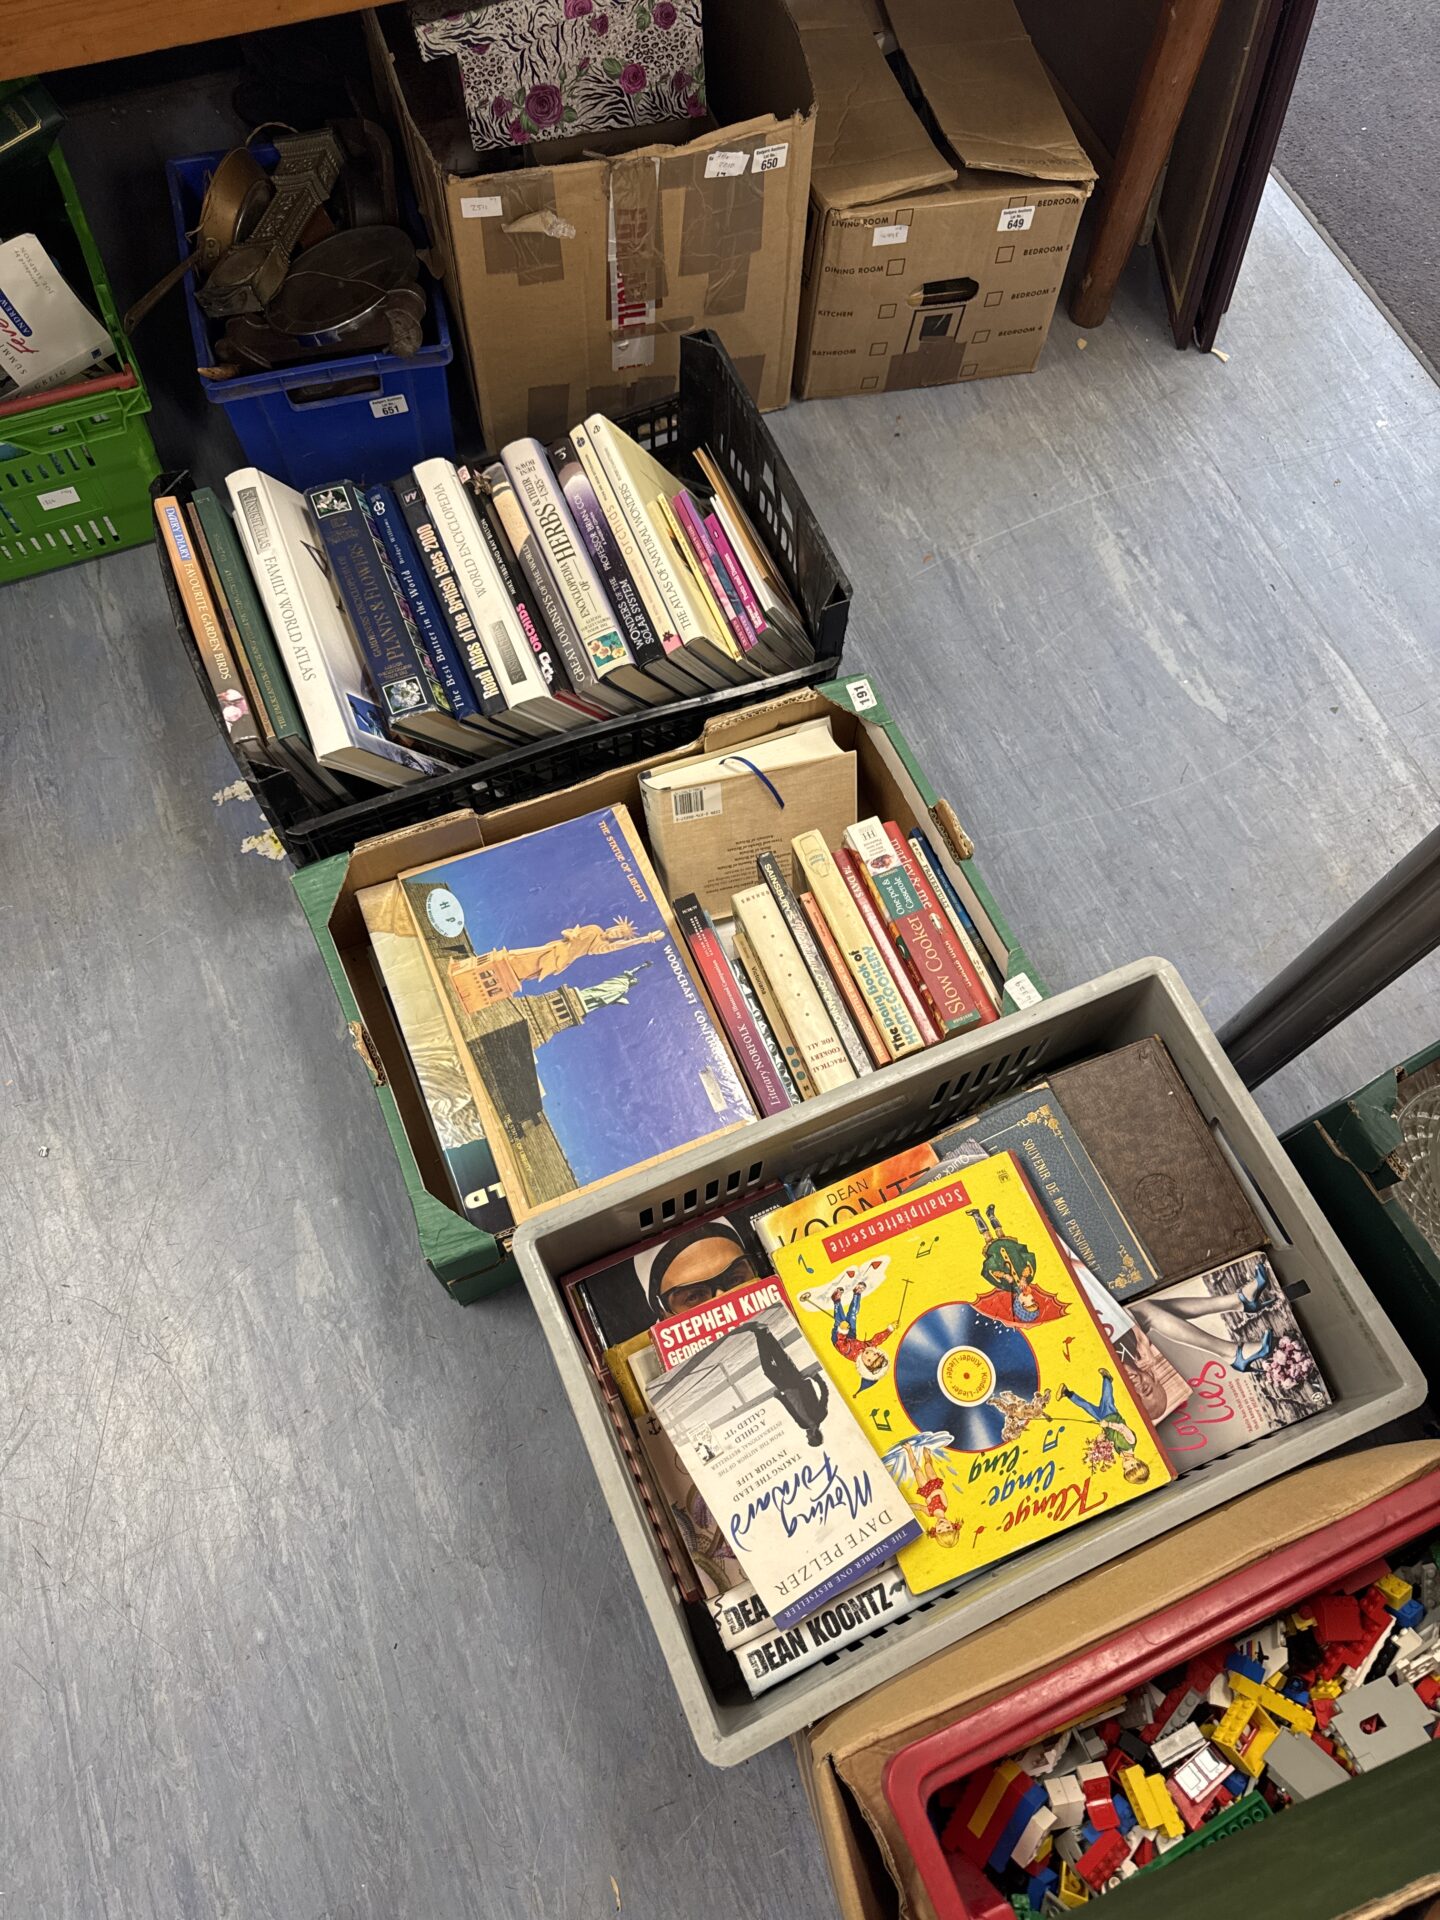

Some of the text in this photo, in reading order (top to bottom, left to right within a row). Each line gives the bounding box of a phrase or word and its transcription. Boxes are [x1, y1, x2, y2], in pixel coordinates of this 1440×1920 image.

[761, 157, 778, 171] 650
[1037, 197, 1079, 207] BEDROOM
[831, 216, 889, 228] LIVING ROOM
[1006, 218, 1025, 230] 649
[1023, 246, 1064, 256] BEDROOM
[824, 265, 884, 275] DINING ROOM
[1011, 290, 1049, 300] BEDROOM
[818, 310, 854, 318] KITCHEN
[998, 328, 1032, 337] BEDROOM
[811, 348, 857, 357] BATHROOM
[34, 369, 66, 390] GREIG
[382, 405, 400, 416] 651
[514, 458, 535, 471] BOWN
[519, 465, 535, 476] DENI
[404, 490, 418, 503] AA
[520, 476, 541, 507] & THEIR
[616, 482, 644, 526] WONDERS
[431, 482, 488, 597] WORLD ENCYCLOPEDIA
[535, 501, 576, 562] HERBS
[572, 493, 611, 571] PROFESSOR BRIAN COX
[603, 504, 633, 555] orchids
[636, 524, 663, 567] NATURAL
[173, 533, 190, 561] DIARY
[480, 518, 516, 594] MIKE TIBBS AND RAY BILTON
[520, 542, 536, 569] WORLD
[347, 541, 380, 600] FLOWERS
[531, 568, 543, 585] THE
[578, 580, 591, 591] OF
[657, 567, 669, 581] OF
[722, 552, 749, 599] Pests and Diseases
[538, 583, 548, 595] OF
[558, 562, 590, 618] ENCYCLOPEDIA
[617, 578, 641, 614] SYSTEM
[662, 580, 683, 610] ATLAS
[183, 562, 208, 612] FAVOURITE
[199, 611, 221, 651] GARDEN
[213, 651, 231, 680] BIRDS
[263, 555, 317, 682] FAMILY WORLD ATLAS
[369, 600, 385, 612] &
[415, 522, 498, 699] Road Atlas of the British Isles 2000
[541, 593, 571, 647] JOURNEYS
[608, 576, 645, 649] WONDERS OF THE
[676, 609, 692, 629] THE
[373, 610, 404, 660] PLANTS
[401, 569, 464, 709] The Best Butter in the World
[515, 602, 542, 652] ORCHIDS
[633, 613, 655, 645] SOLAR
[564, 646, 586, 682] GREAT
[854, 685, 870, 705] 191
[597, 820, 648, 904] THE STATUE OF LIBERTY
[890, 836, 918, 877] marley
[909, 874, 923, 889] &
[916, 888, 933, 910] me
[842, 864, 864, 899] 74 DAYS
[881, 878, 906, 915] One-pot &
[892, 876, 914, 909] Casserole
[700, 933, 714, 955] KATHLEEN
[902, 913, 944, 974] Cooker
[661, 944, 698, 1006] WOODCRAFT
[711, 958, 728, 987] Companion
[750, 965, 767, 995] Victoriana
[723, 986, 739, 1012] Illustrated
[814, 973, 844, 1030] COMPANION
[825, 944, 878, 1043] SECOND LITTLE BOOK OF HUGS
[849, 948, 906, 1051] The Dairy Book of
[932, 971, 965, 1015] Slow
[807, 1036, 834, 1050] FOR ALL
[808, 1046, 841, 1062] COOKERY
[736, 1022, 782, 1107] Literary NORFOLK
[811, 1056, 846, 1073] PRACTICAL
[943, 1155, 970, 1177] Quick
[1021, 1137, 1071, 1217] SOUVENIR DE MON
[825, 1177, 868, 1206] DEAN
[749, 1204, 781, 1220] PARENTAL
[829, 1187, 962, 1253] Schallplattenserie
[658, 1301, 738, 1349] STEPHEN
[737, 1282, 783, 1316] KING
[1227, 1380, 1239, 1399] sparkle
[733, 1423, 759, 1444] CHILD
[735, 1407, 766, 1430] CALLED
[710, 1420, 783, 1470] INTERNATIONAL BESTSELLER
[758, 1440, 769, 1448] THE
[768, 1430, 784, 1442] FROM
[717, 1467, 728, 1476] THE
[735, 1449, 787, 1487] IN YOUR LIFE
[736, 1447, 757, 1464] AUTHOR
[731, 1452, 802, 1503] TAKING THE LEAD
[729, 1451, 839, 1553] Forward
[781, 1470, 873, 1538] Moving
[773, 1509, 892, 1598] DAVE PELZER
[783, 1529, 906, 1619] THE NUMBER ONE BESTSELLER
[745, 1583, 893, 1678] DEAN KOONTZ
